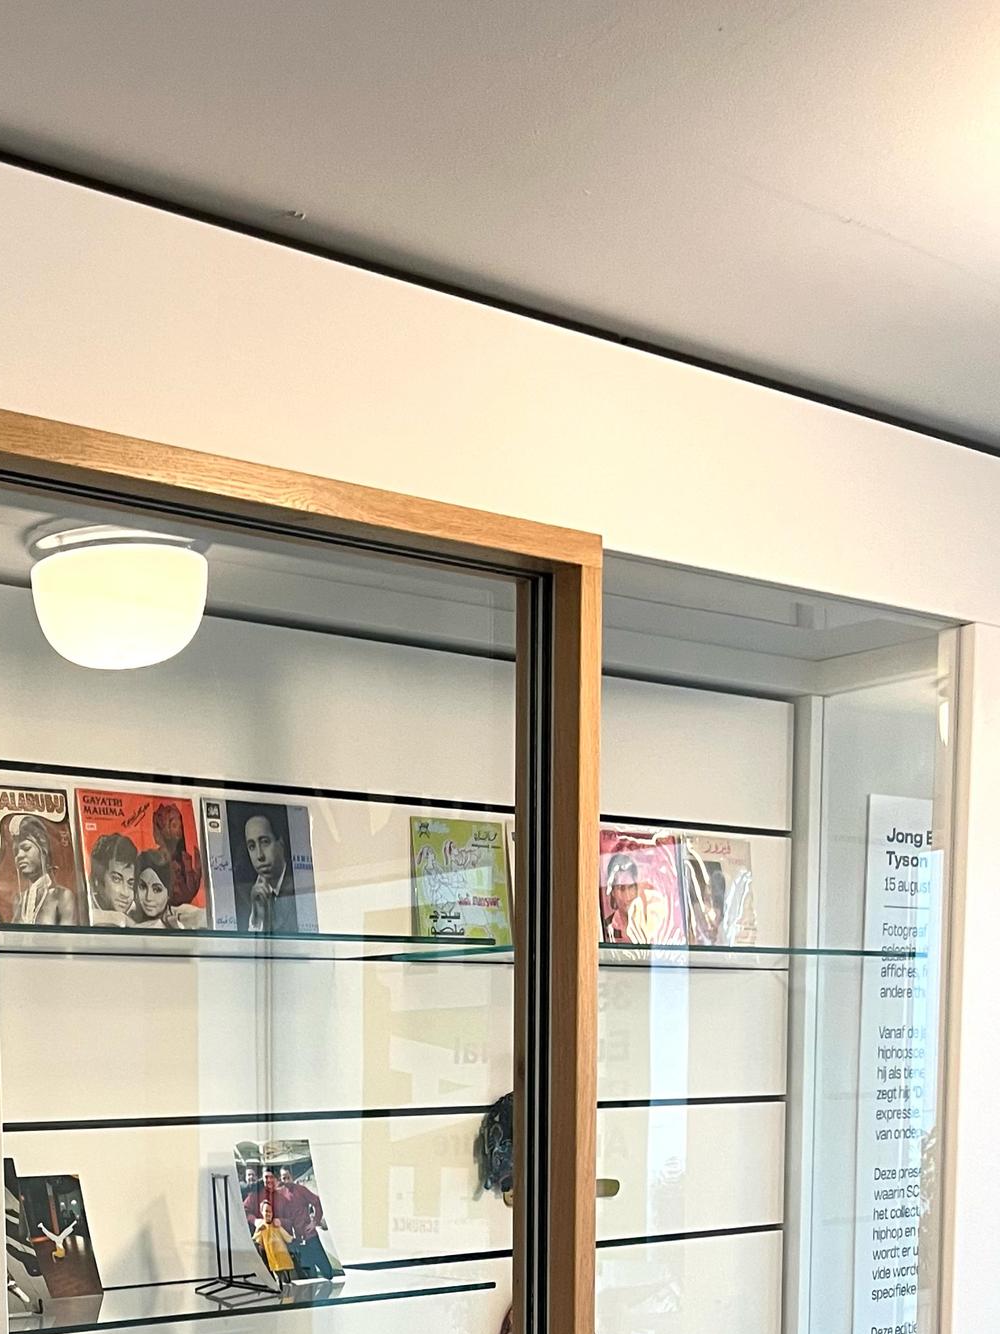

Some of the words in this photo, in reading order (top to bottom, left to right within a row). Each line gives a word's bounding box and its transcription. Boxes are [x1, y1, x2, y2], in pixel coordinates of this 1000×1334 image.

[886, 827, 923, 848] Jong
[886, 850, 928, 870] Tyson
[884, 877, 896, 892] 15
[879, 984, 913, 998] andere
[879, 1024, 906, 1039] Vanaf
[888, 1065, 902, 1080] als
[876, 1086, 897, 1103] zegt
[875, 1128, 893, 1141] van
[873, 1167, 897, 1181] Deze
[873, 1187, 905, 1201] waarin
[873, 1207, 888, 1221] het
[872, 1225, 903, 1243] hiphop
[904, 1225, 916, 1238] en
[872, 1245, 900, 1260] wordt
[901, 1245, 912, 1258] er
[872, 1266, 891, 1281] vide
[871, 1283, 917, 1303] specifieke
